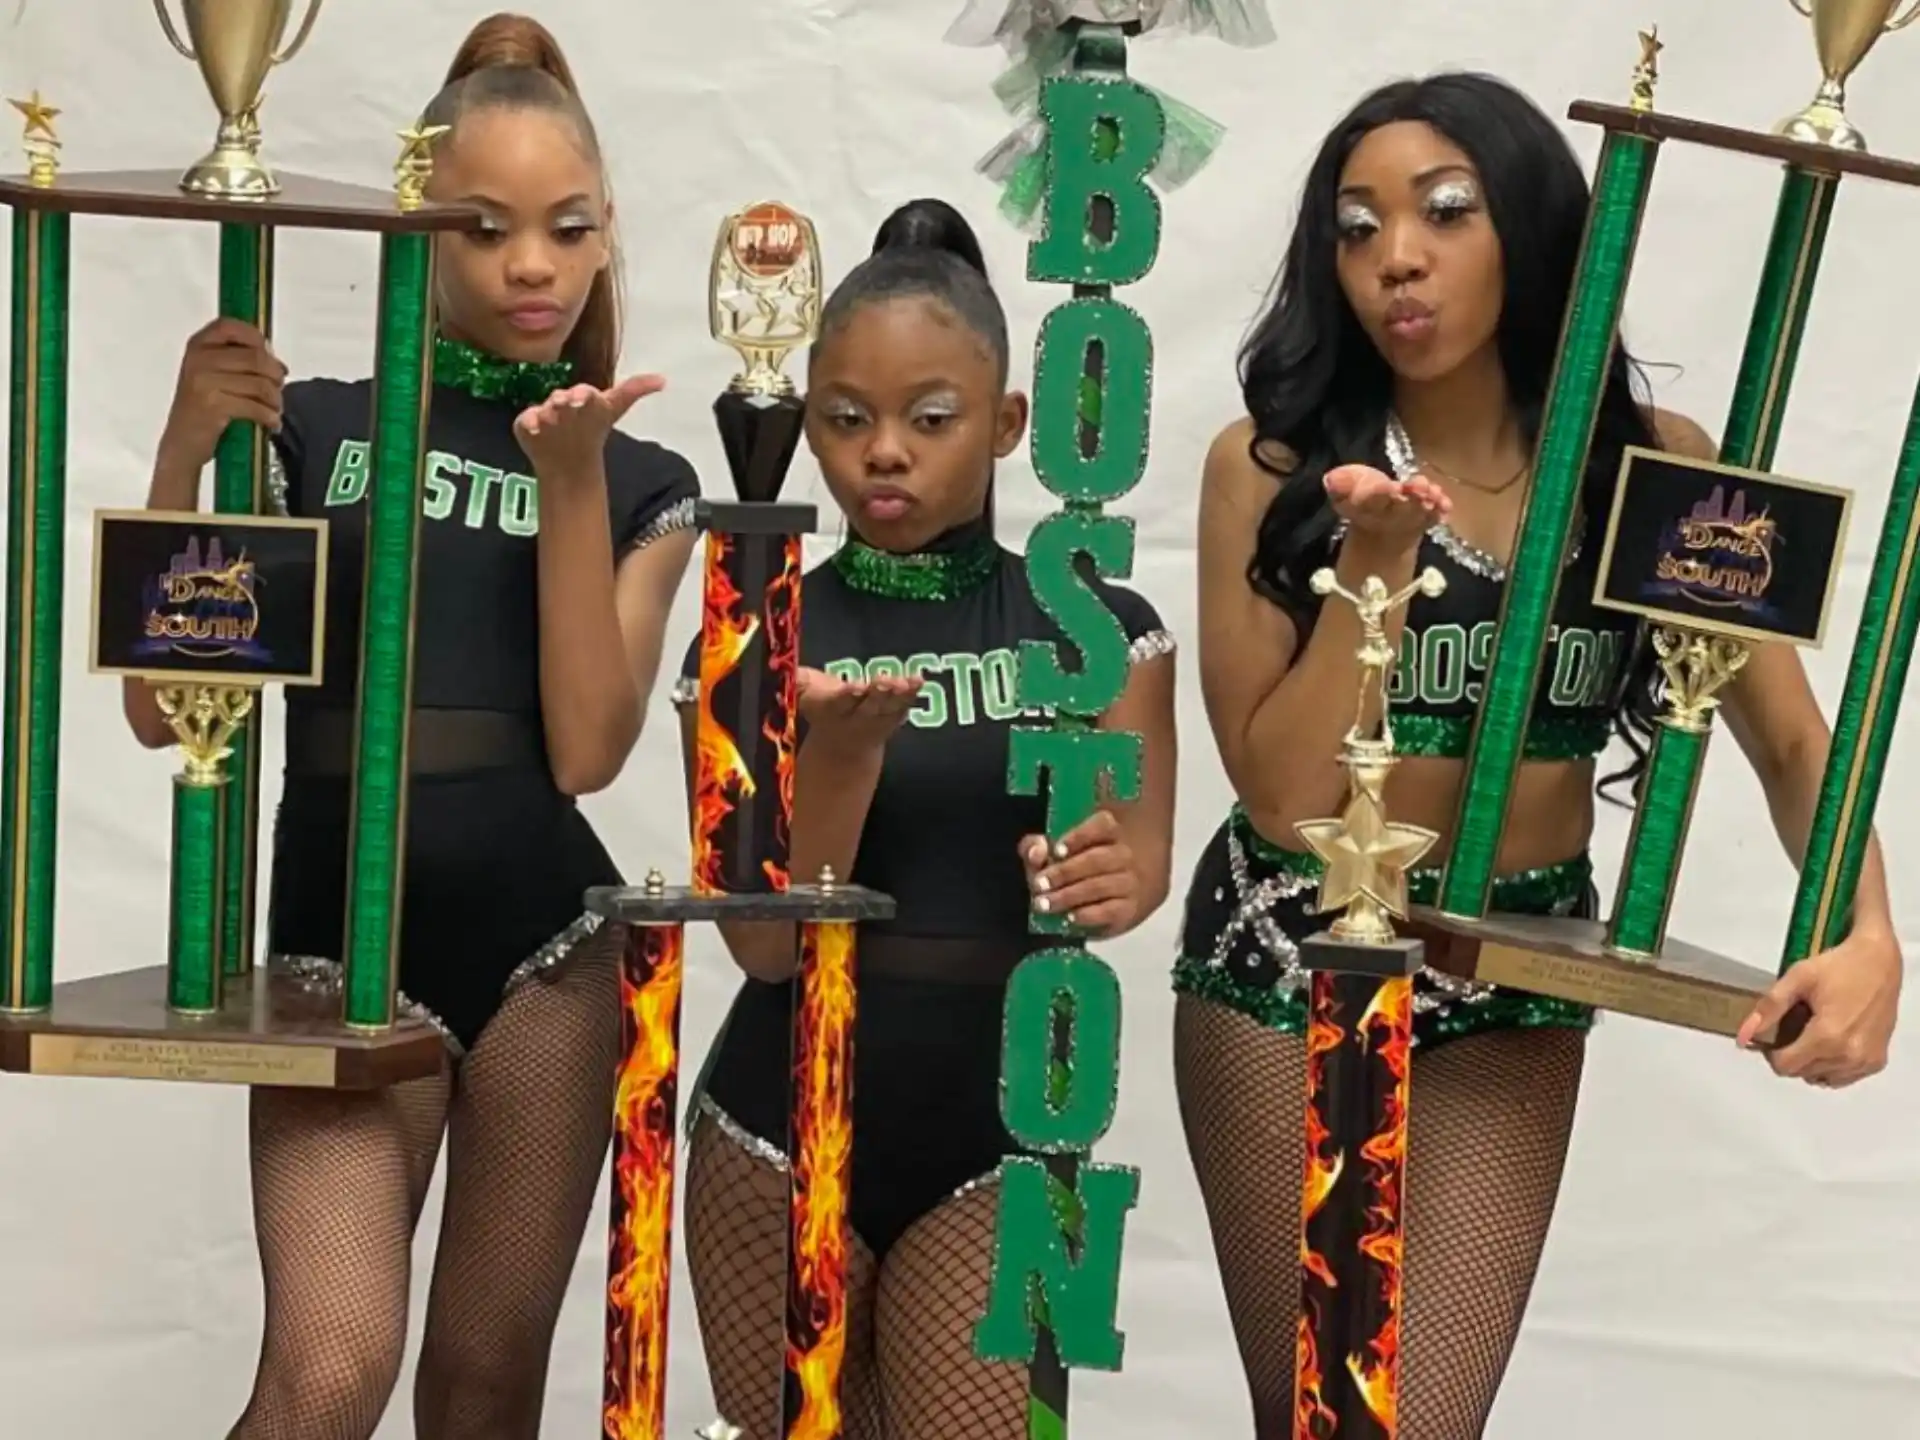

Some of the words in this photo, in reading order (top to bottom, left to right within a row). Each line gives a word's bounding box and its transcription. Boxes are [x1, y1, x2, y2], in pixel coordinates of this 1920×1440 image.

[324, 439, 539, 536] BSTO
[1656, 555, 1767, 597] SOUTH
[144, 612, 253, 641] SOUTH
[824, 647, 1056, 728] STO
[972, 75, 1166, 1372] BOSTON
